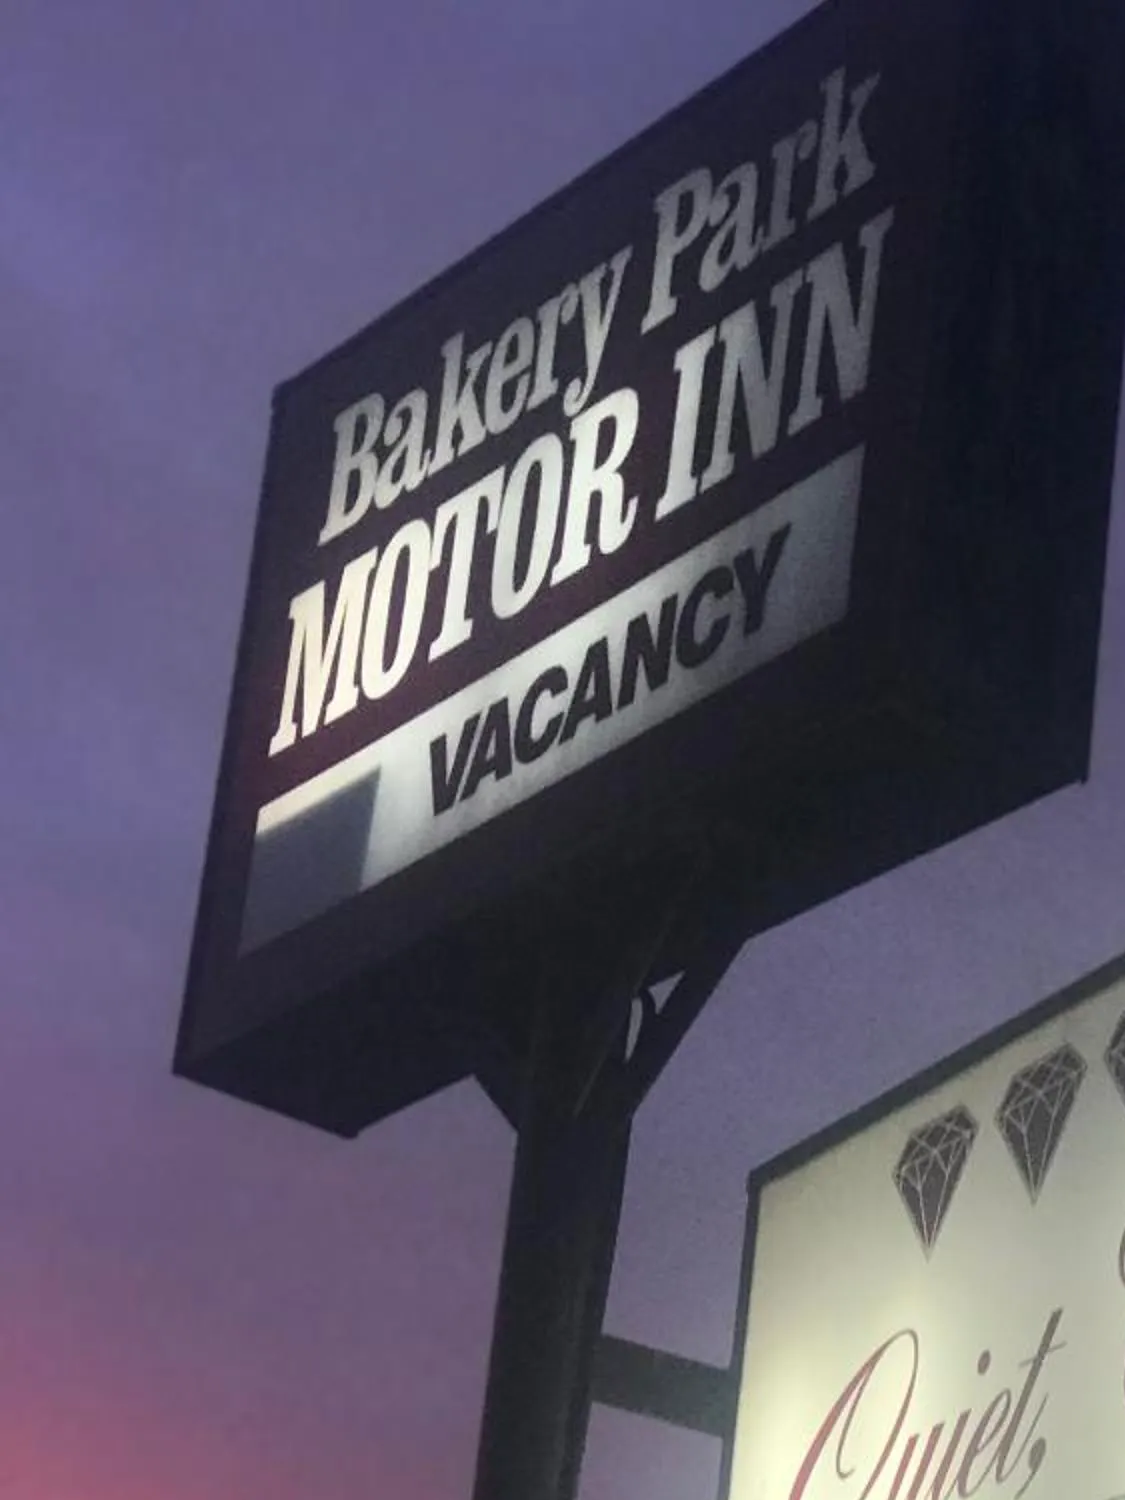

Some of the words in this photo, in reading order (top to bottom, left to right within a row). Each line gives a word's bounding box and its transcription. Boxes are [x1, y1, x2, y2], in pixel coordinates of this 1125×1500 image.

[268, 387, 640, 758] MOTOR
[655, 205, 894, 523] INN
[318, 245, 633, 546] Bakery
[639, 64, 882, 334] Park
[428, 521, 793, 817] VACANCY
